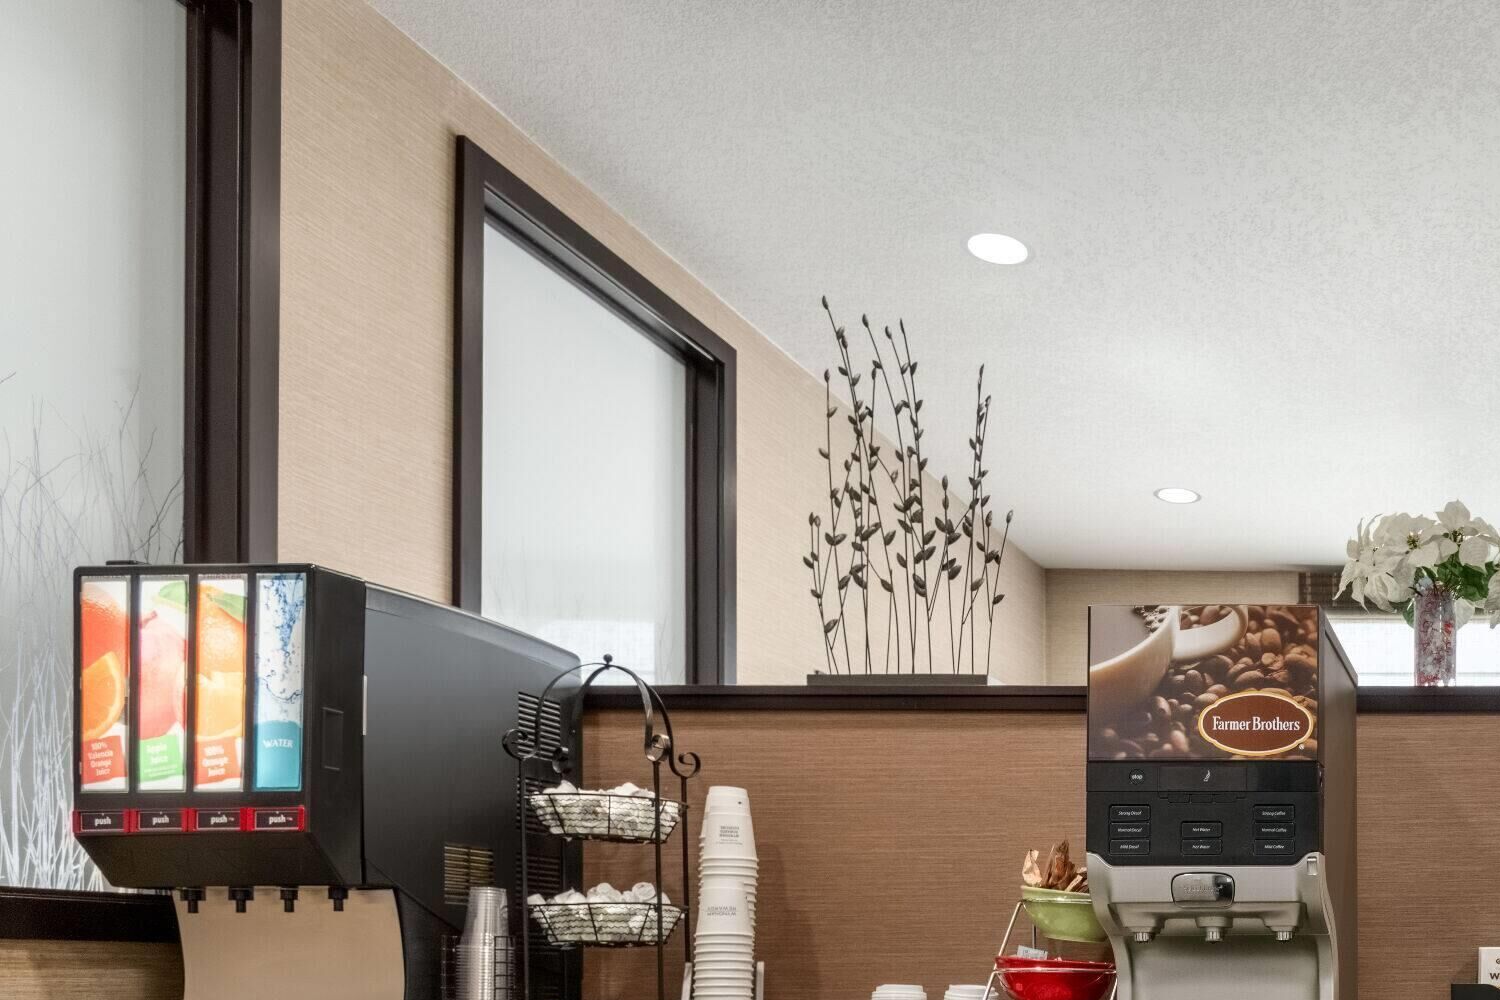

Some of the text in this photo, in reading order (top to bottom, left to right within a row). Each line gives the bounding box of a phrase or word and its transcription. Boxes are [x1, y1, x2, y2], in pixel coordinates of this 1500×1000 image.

[1212, 716, 1300, 731] Farmer Brothers
[91, 742, 108, 751] 100%
[262, 738, 294, 749] WATER
[88, 750, 114, 760] Valencia
[90, 758, 112, 769] Orange
[202, 755, 229, 767] Orange
[95, 767, 111, 777] Juice
[207, 767, 226, 777] Juice
[94, 816, 112, 827] push
[152, 815, 170, 826] push
[210, 815, 228, 826] push
[268, 814, 286, 825] push
